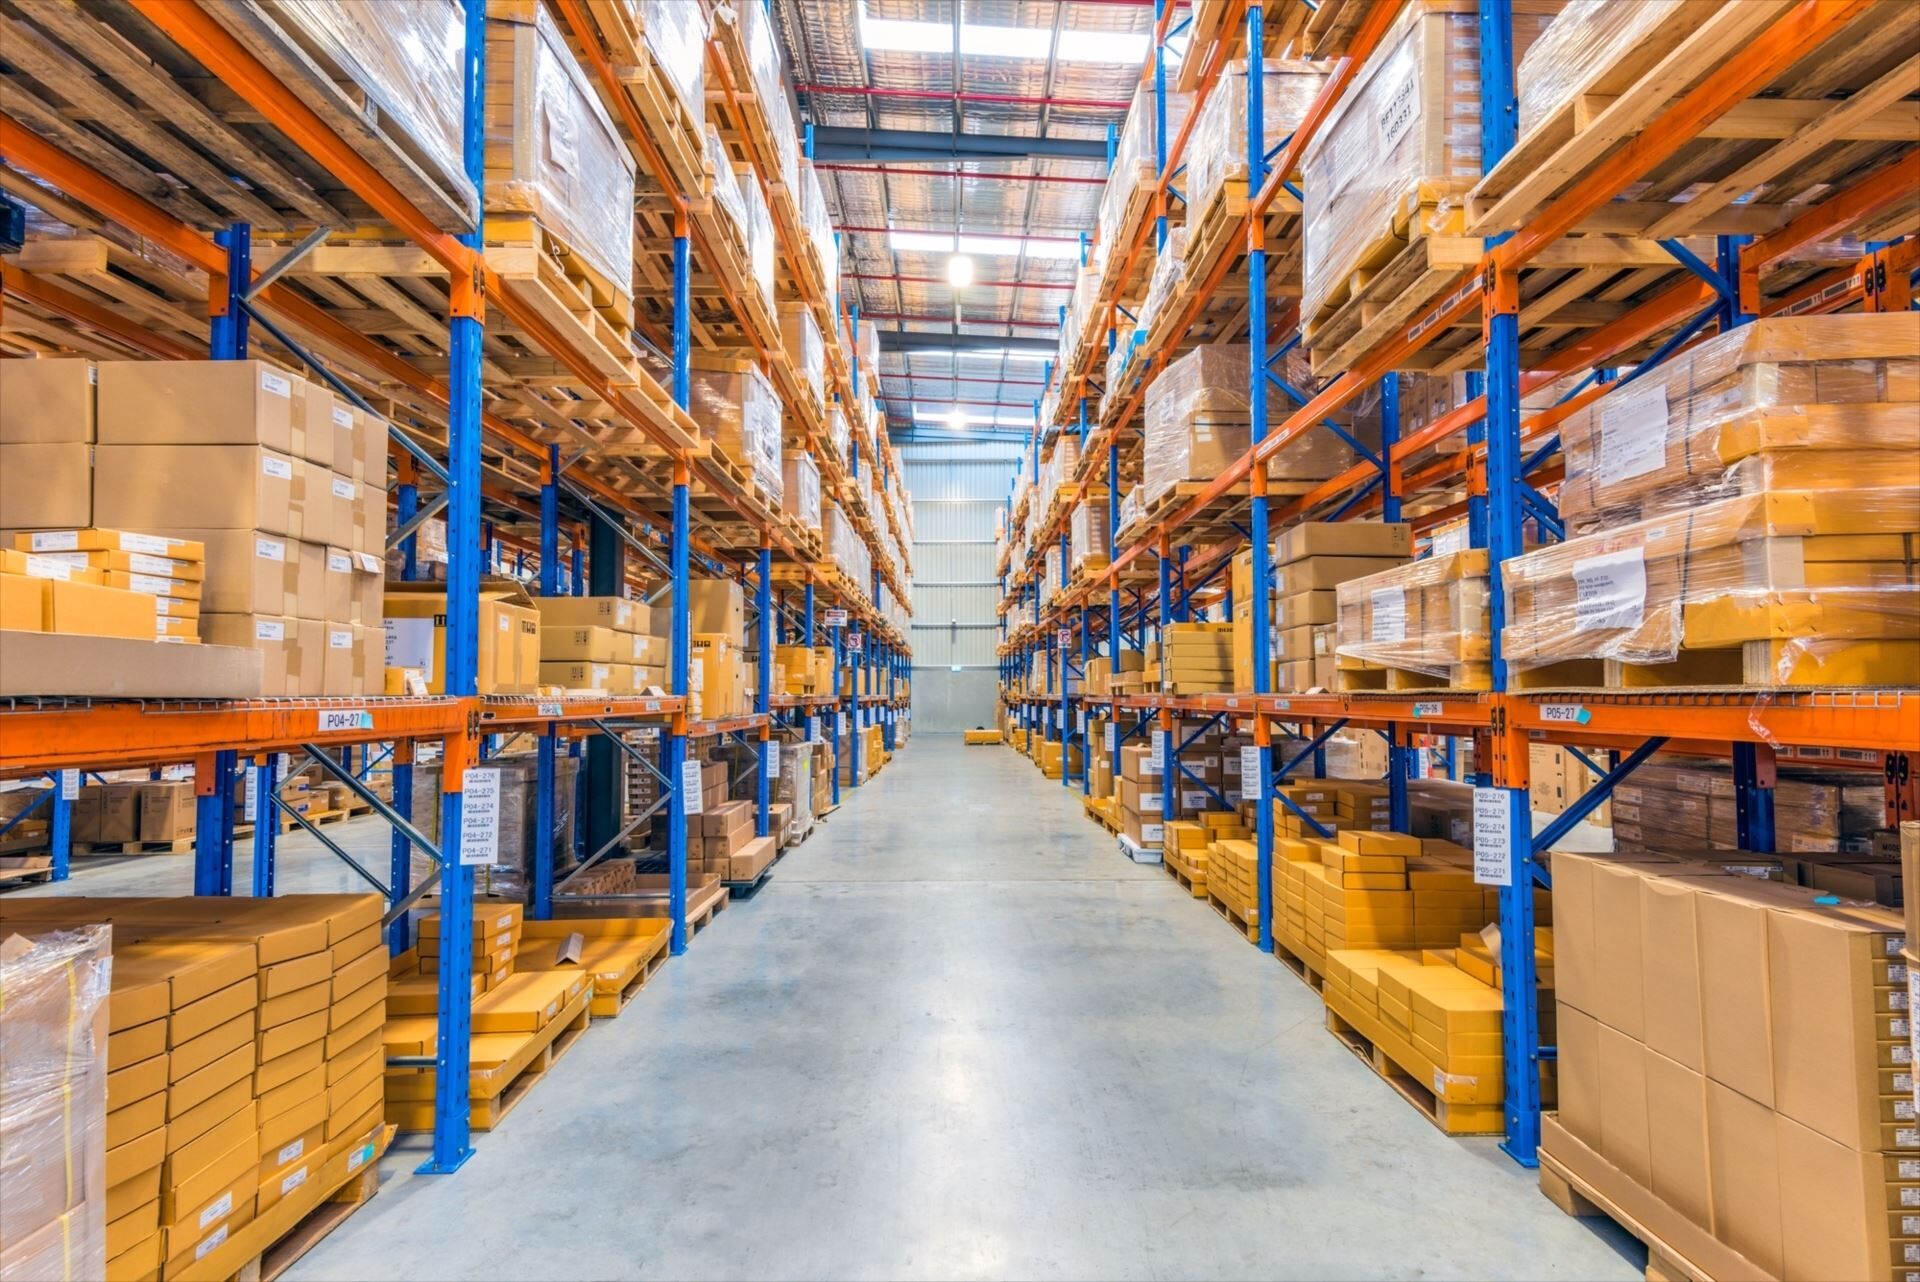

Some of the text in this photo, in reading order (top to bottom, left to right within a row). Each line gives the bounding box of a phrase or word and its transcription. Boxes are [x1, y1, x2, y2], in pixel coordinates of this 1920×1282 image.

[1546, 707, 1575, 720] P05-27
[327, 713, 360, 728] P04-27
[1475, 822, 1505, 830] P05-274
[1476, 851, 1506, 860] P05-272
[1476, 866, 1506, 875] P05-271
